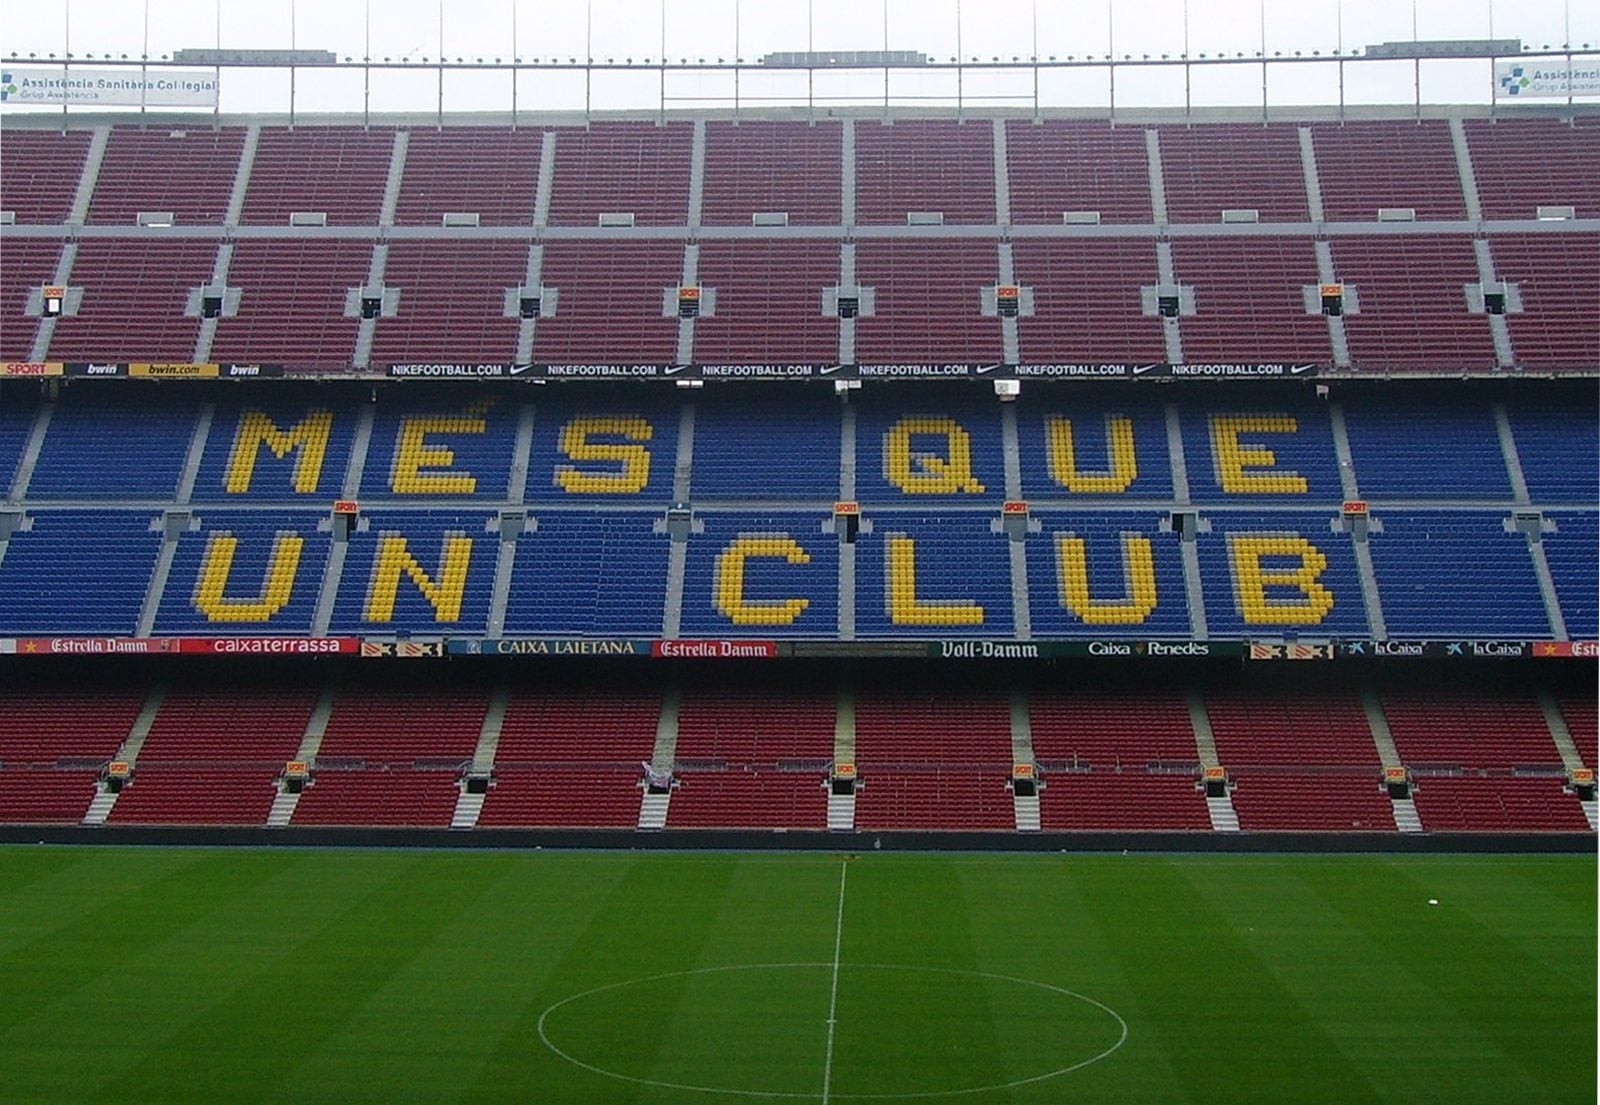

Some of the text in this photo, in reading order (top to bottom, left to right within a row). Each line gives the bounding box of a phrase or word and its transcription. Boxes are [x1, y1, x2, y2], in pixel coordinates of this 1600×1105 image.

[6, 363, 47, 375] SPORT
[87, 364, 118, 375] bwin
[149, 364, 200, 376] bwin.com
[230, 364, 260, 376] bwin
[392, 365, 502, 375] NIKEFOOTBALL.COM
[548, 365, 657, 375] NIKEFOOTBALL.COM
[702, 365, 812, 375] NIKEFOOTBALL.COM
[858, 365, 968, 375] NIKEFOOTBALL.COM
[1014, 365, 1125, 375] NIKEFOOTBALL.COM
[1172, 365, 1283, 375] NIKEFOOTBALL.COM
[224, 398, 1308, 495] MÉS QUE
[335, 502, 356, 511] SPORT
[835, 504, 856, 512] SPORT
[1004, 503, 1026, 512] SPORT
[1344, 503, 1365, 511] SPORT
[192, 531, 1334, 625] UN CLUB
[51, 639, 148, 652] Estrella Damm
[214, 638, 340, 652] caixaterrassa
[498, 641, 634, 654] CAIXA LAIETANA
[660, 641, 767, 656] Estrella Damm
[941, 642, 1039, 658] Voll-Damm
[1088, 642, 1209, 655] Caixa Penedès
